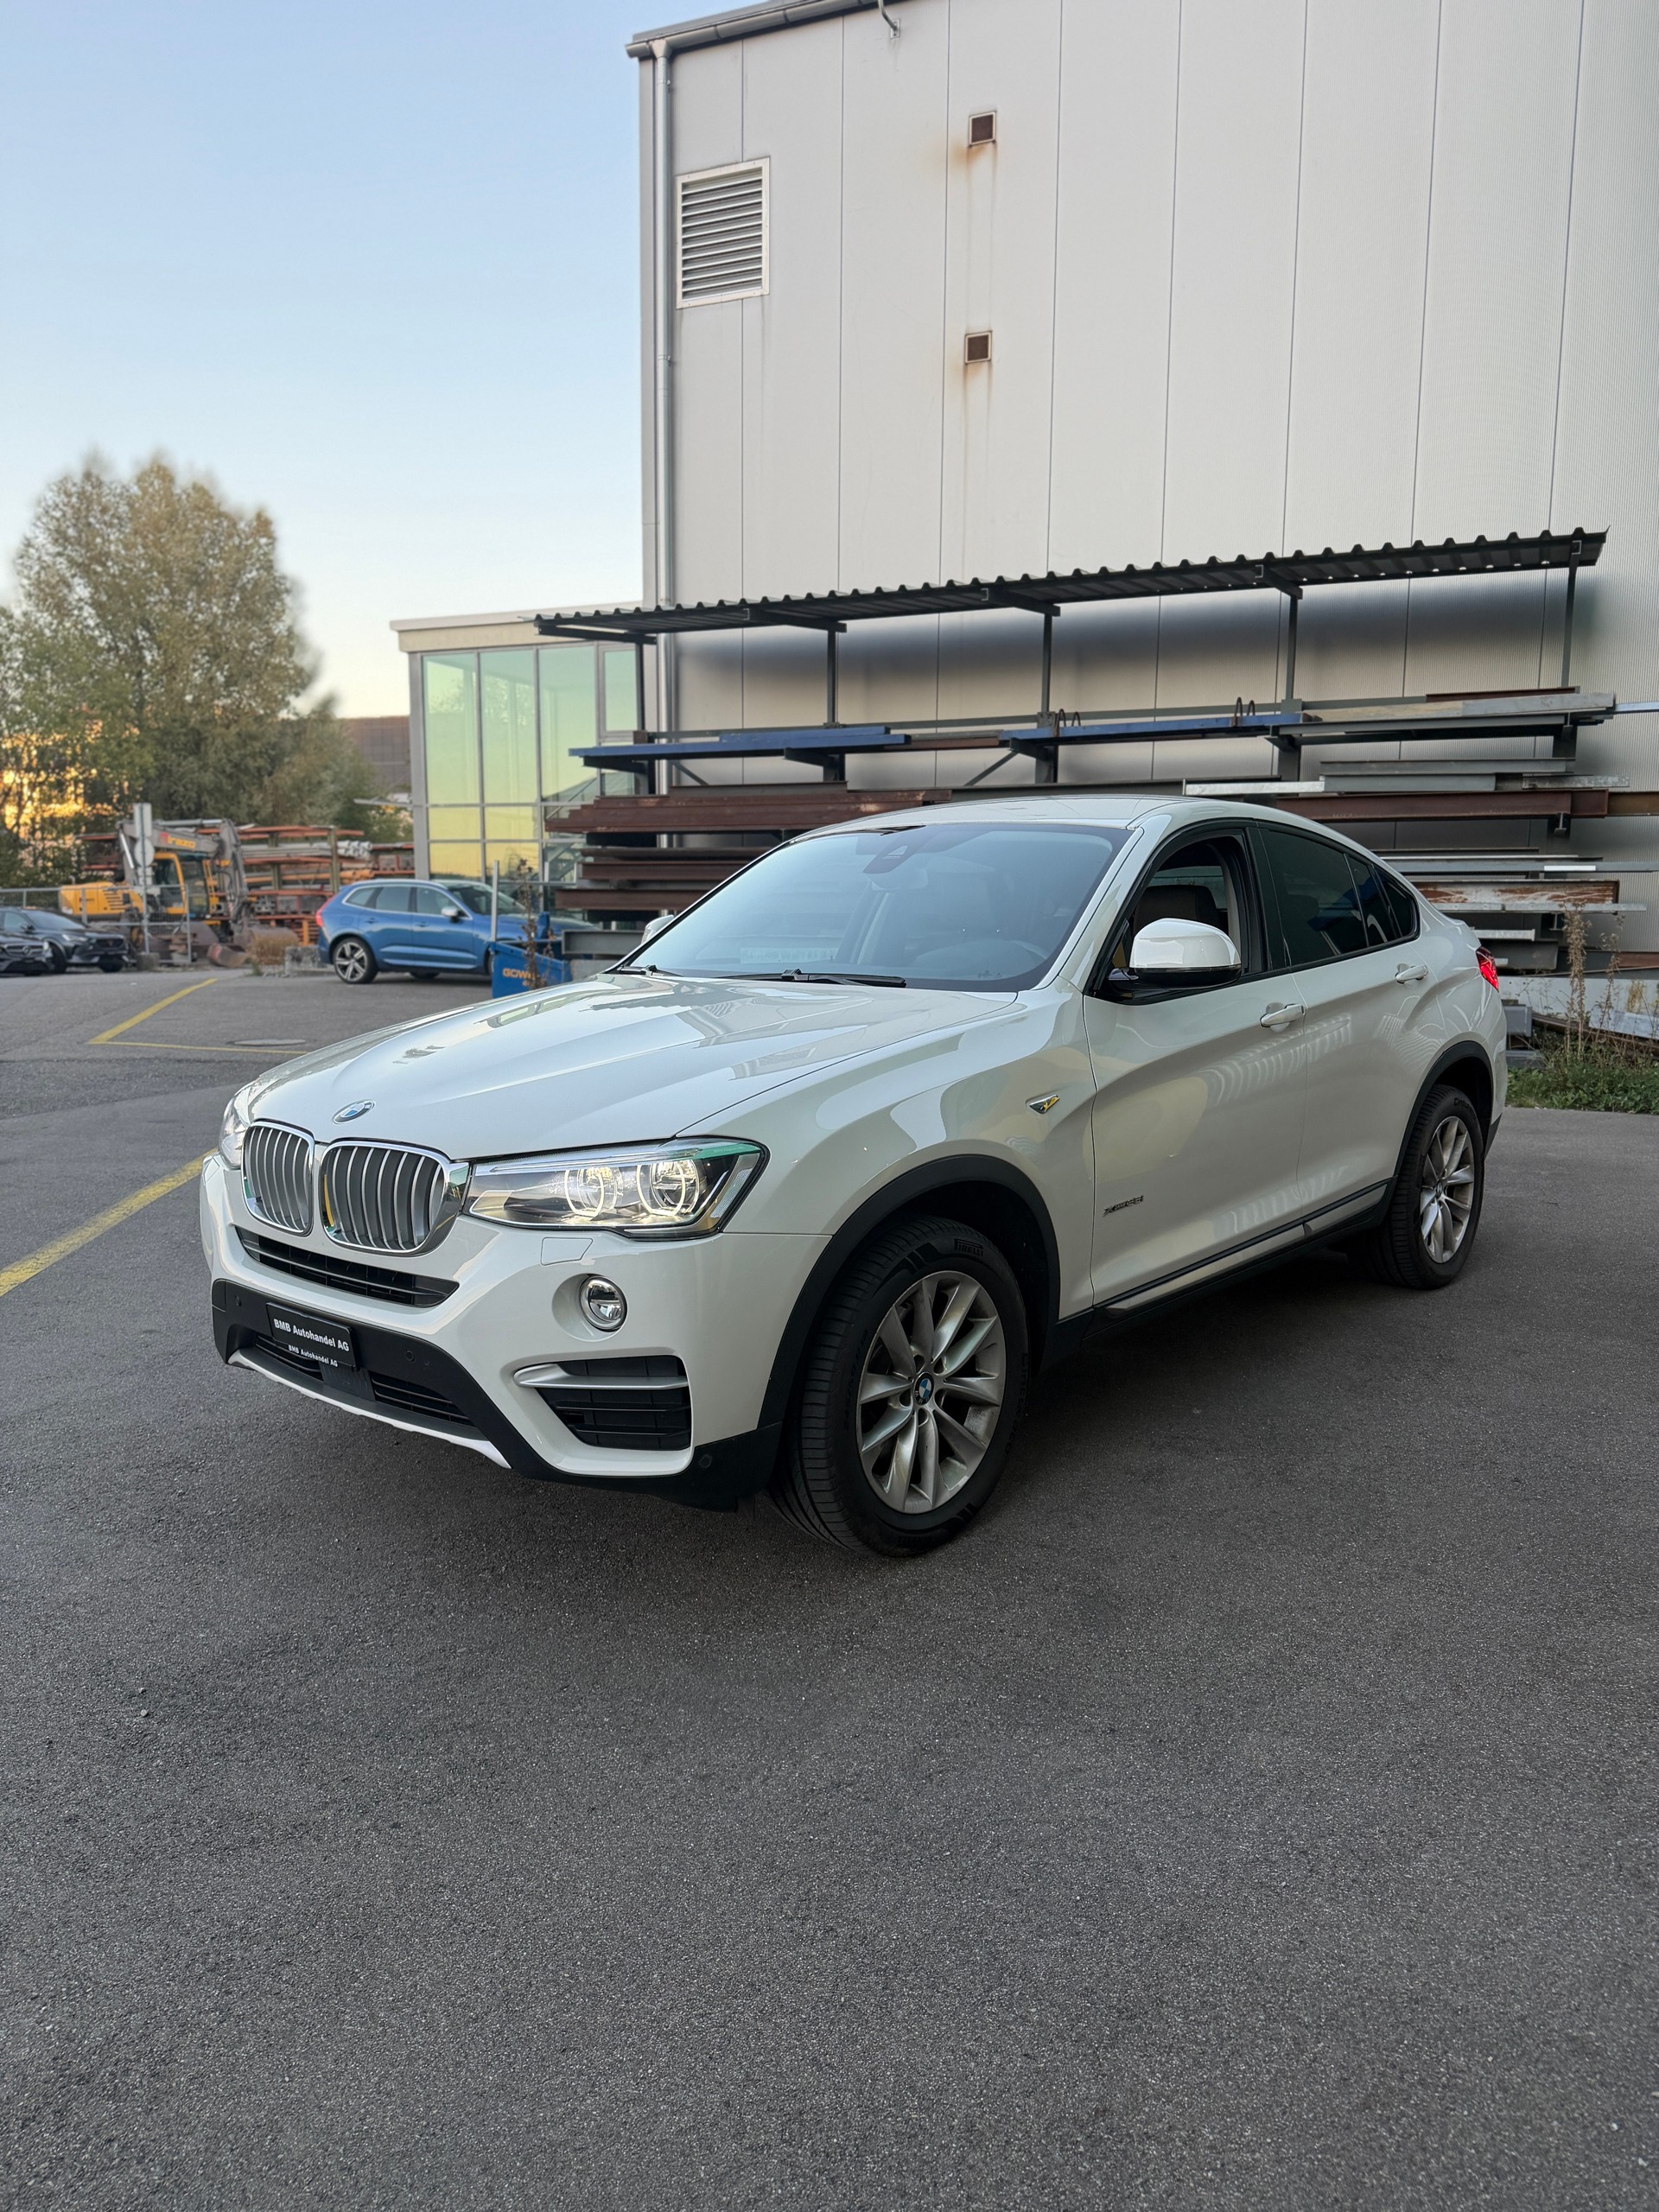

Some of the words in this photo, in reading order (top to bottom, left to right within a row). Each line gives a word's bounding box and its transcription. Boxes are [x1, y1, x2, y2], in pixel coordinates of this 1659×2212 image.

[953, 1237, 984, 1257] PIRELLI
[273, 1319, 292, 1333] BMB
[292, 1325, 336, 1348] Autohandel
[337, 1339, 350, 1352] AG
[288, 1344, 300, 1354] BMB
[300, 1349, 329, 1364] Autohandel
